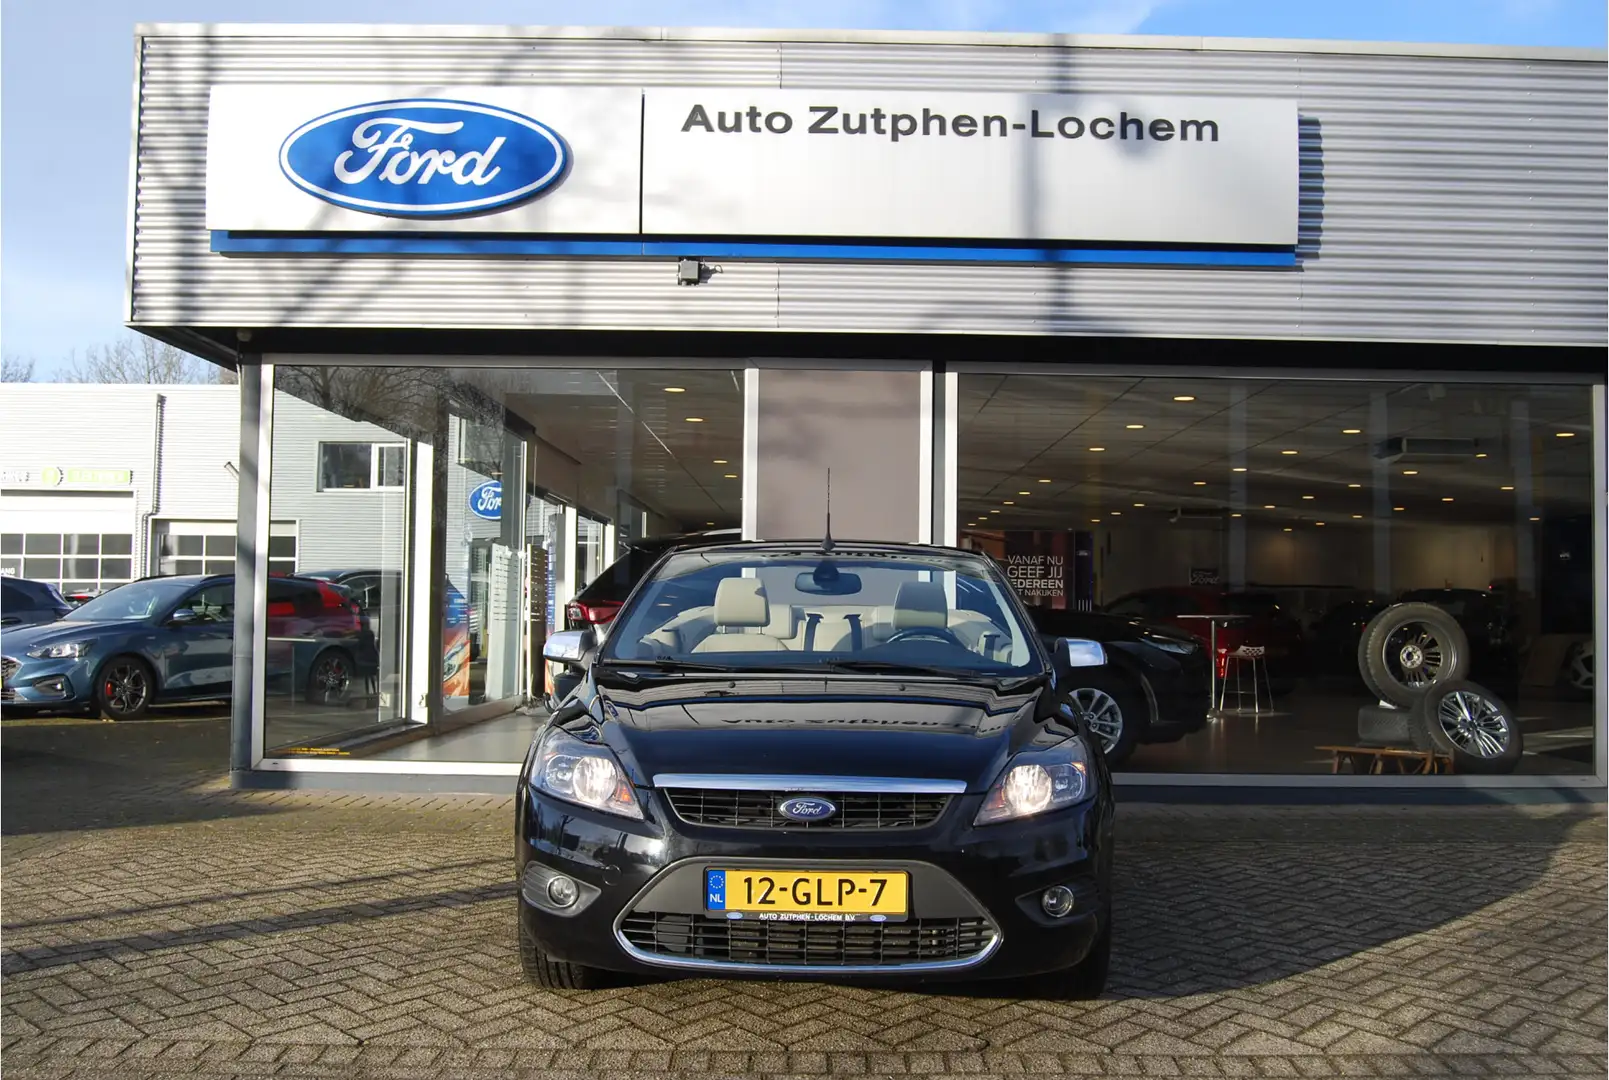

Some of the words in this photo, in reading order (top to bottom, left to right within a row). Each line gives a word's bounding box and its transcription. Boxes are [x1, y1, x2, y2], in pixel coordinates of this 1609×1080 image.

[681, 104, 793, 134] Auto
[808, 106, 1220, 142] Zutphen-Lochem
[333, 116, 507, 185] Ford
[477, 486, 502, 511] For
[1007, 555, 1045, 565] VANAF
[1046, 556, 1064, 566] NU
[1007, 565, 1045, 578] GEEF
[1047, 566, 1063, 578] JIJ
[1010, 579, 1064, 589] EDEREEN
[792, 802, 822, 815] Ford
[743, 876, 888, 907] 12-GLP-7
[709, 894, 723, 903] NL
